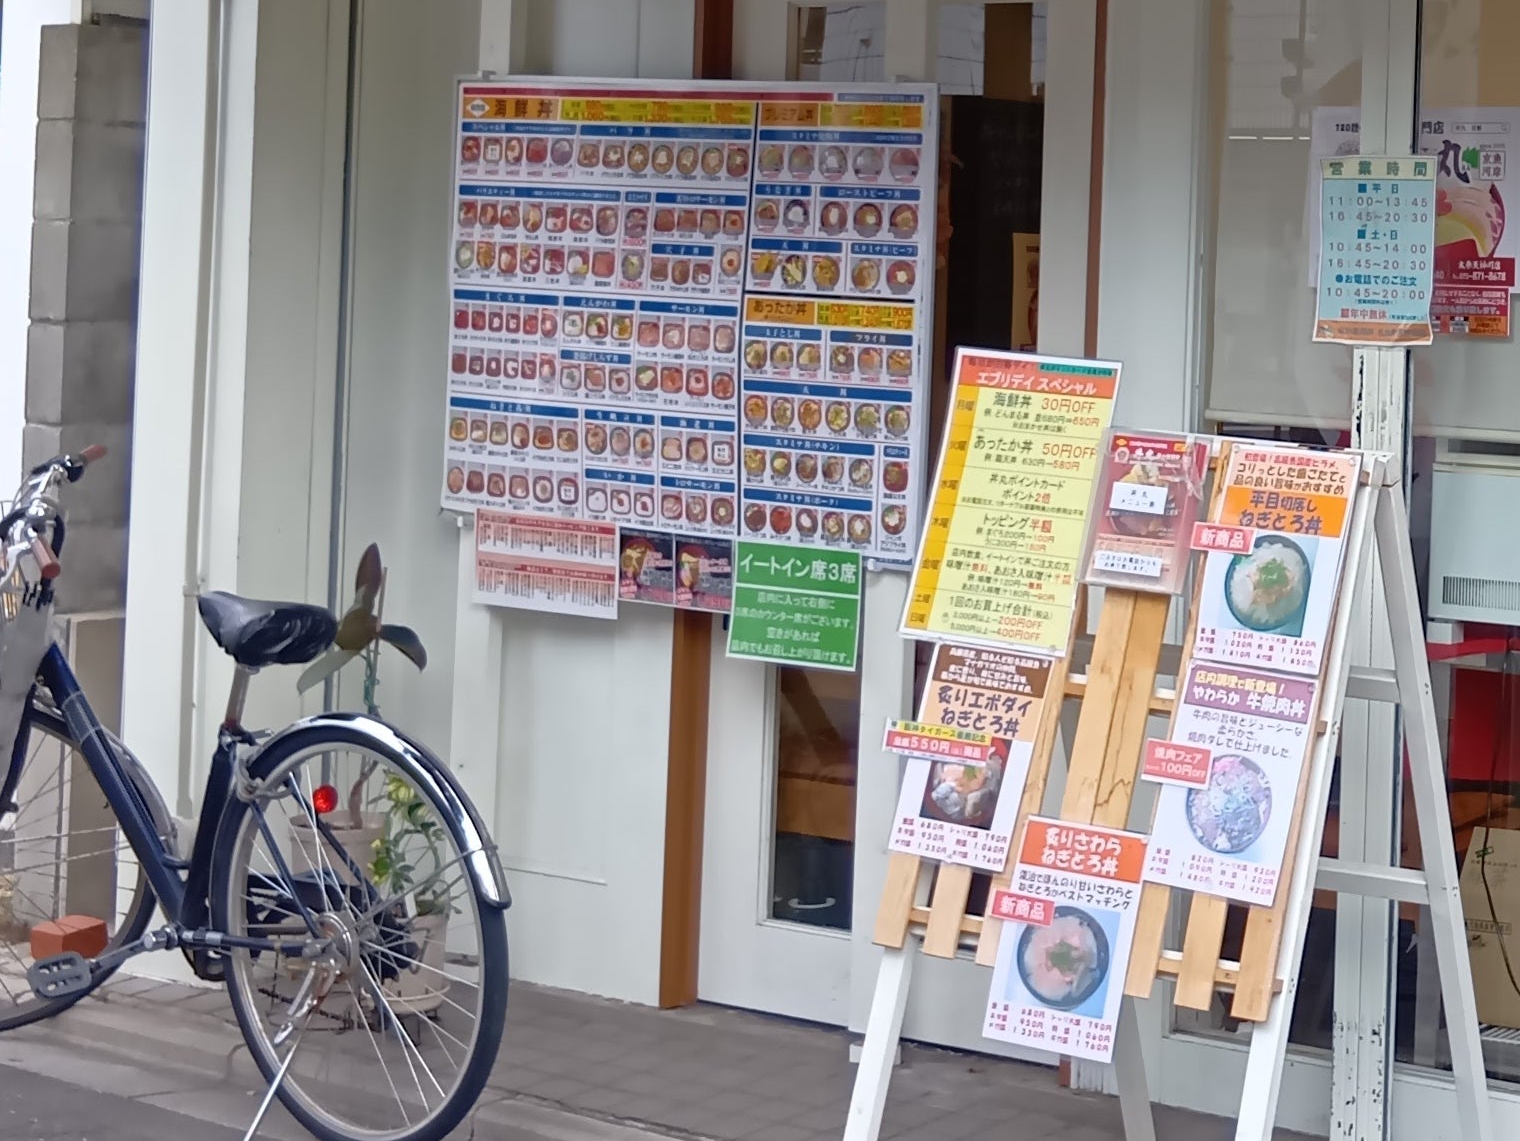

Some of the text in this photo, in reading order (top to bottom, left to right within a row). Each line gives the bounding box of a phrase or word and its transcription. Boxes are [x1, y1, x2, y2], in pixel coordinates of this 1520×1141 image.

[1421, 121, 1444, 134] 門店
[1329, 161, 1427, 177] 営業時間
[1372, 183, 1400, 194] 平日
[1370, 229, 1399, 241] 土・日
[1345, 275, 1418, 287] お電話でのご注文
[753, 301, 808, 317] あったか丼
[976, 371, 1097, 395] エブリデイ スペシャル
[993, 392, 1096, 413] 海鮮丼 30円OFF
[973, 436, 1097, 459] あったか丼 50円OFF
[989, 473, 1066, 491] 丼丸ポイントカード
[1234, 475, 1344, 495] 品の良い旨味がおすすめ
[1002, 490, 1051, 504] ポイント2倍
[1250, 490, 1318, 513] 平目切落し
[983, 513, 1053, 534] トッピング半額
[1239, 509, 1322, 536] ねぎとろ丼
[1200, 528, 1245, 549] 新商品
[740, 553, 857, 584] イートイン席3席
[937, 685, 1033, 718] 炙りエボダイ
[1193, 685, 1306, 718] やわらか 牛焼肉丼
[940, 707, 1020, 738] ねぎとろ丼
[1193, 709, 1304, 737] 牛肉の旨味とジューシーな
[1154, 746, 1203, 764] 焼肉フェア
[1161, 762, 1206, 778] 100円OFF
[1045, 826, 1122, 856] 炙りさわら
[1041, 845, 1119, 877] ねぎとろ丼
[1018, 881, 1131, 911] ねぎとろがベストマッチング
[999, 894, 1045, 921] 新商品
